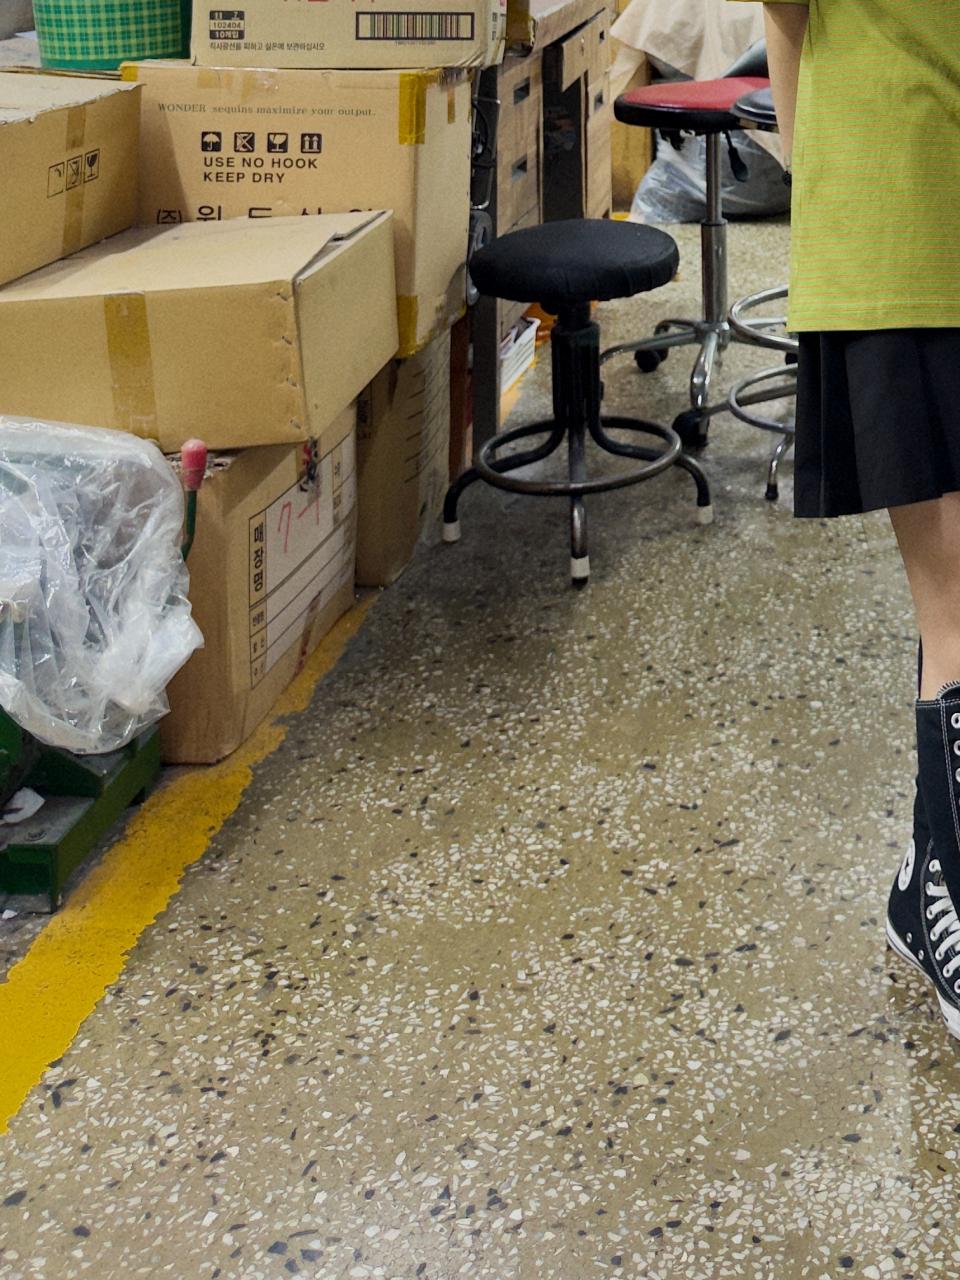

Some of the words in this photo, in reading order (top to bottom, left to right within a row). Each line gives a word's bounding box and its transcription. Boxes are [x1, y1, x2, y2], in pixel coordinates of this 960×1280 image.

[158, 103, 206, 114] WONDER
[213, 105, 253, 116] sequins
[311, 107, 334, 117] your
[203, 156, 236, 169] USE
[242, 156, 265, 169] NO
[271, 157, 318, 170] HOOK
[203, 171, 246, 183] KEEP
[252, 172, 286, 184] DRY
